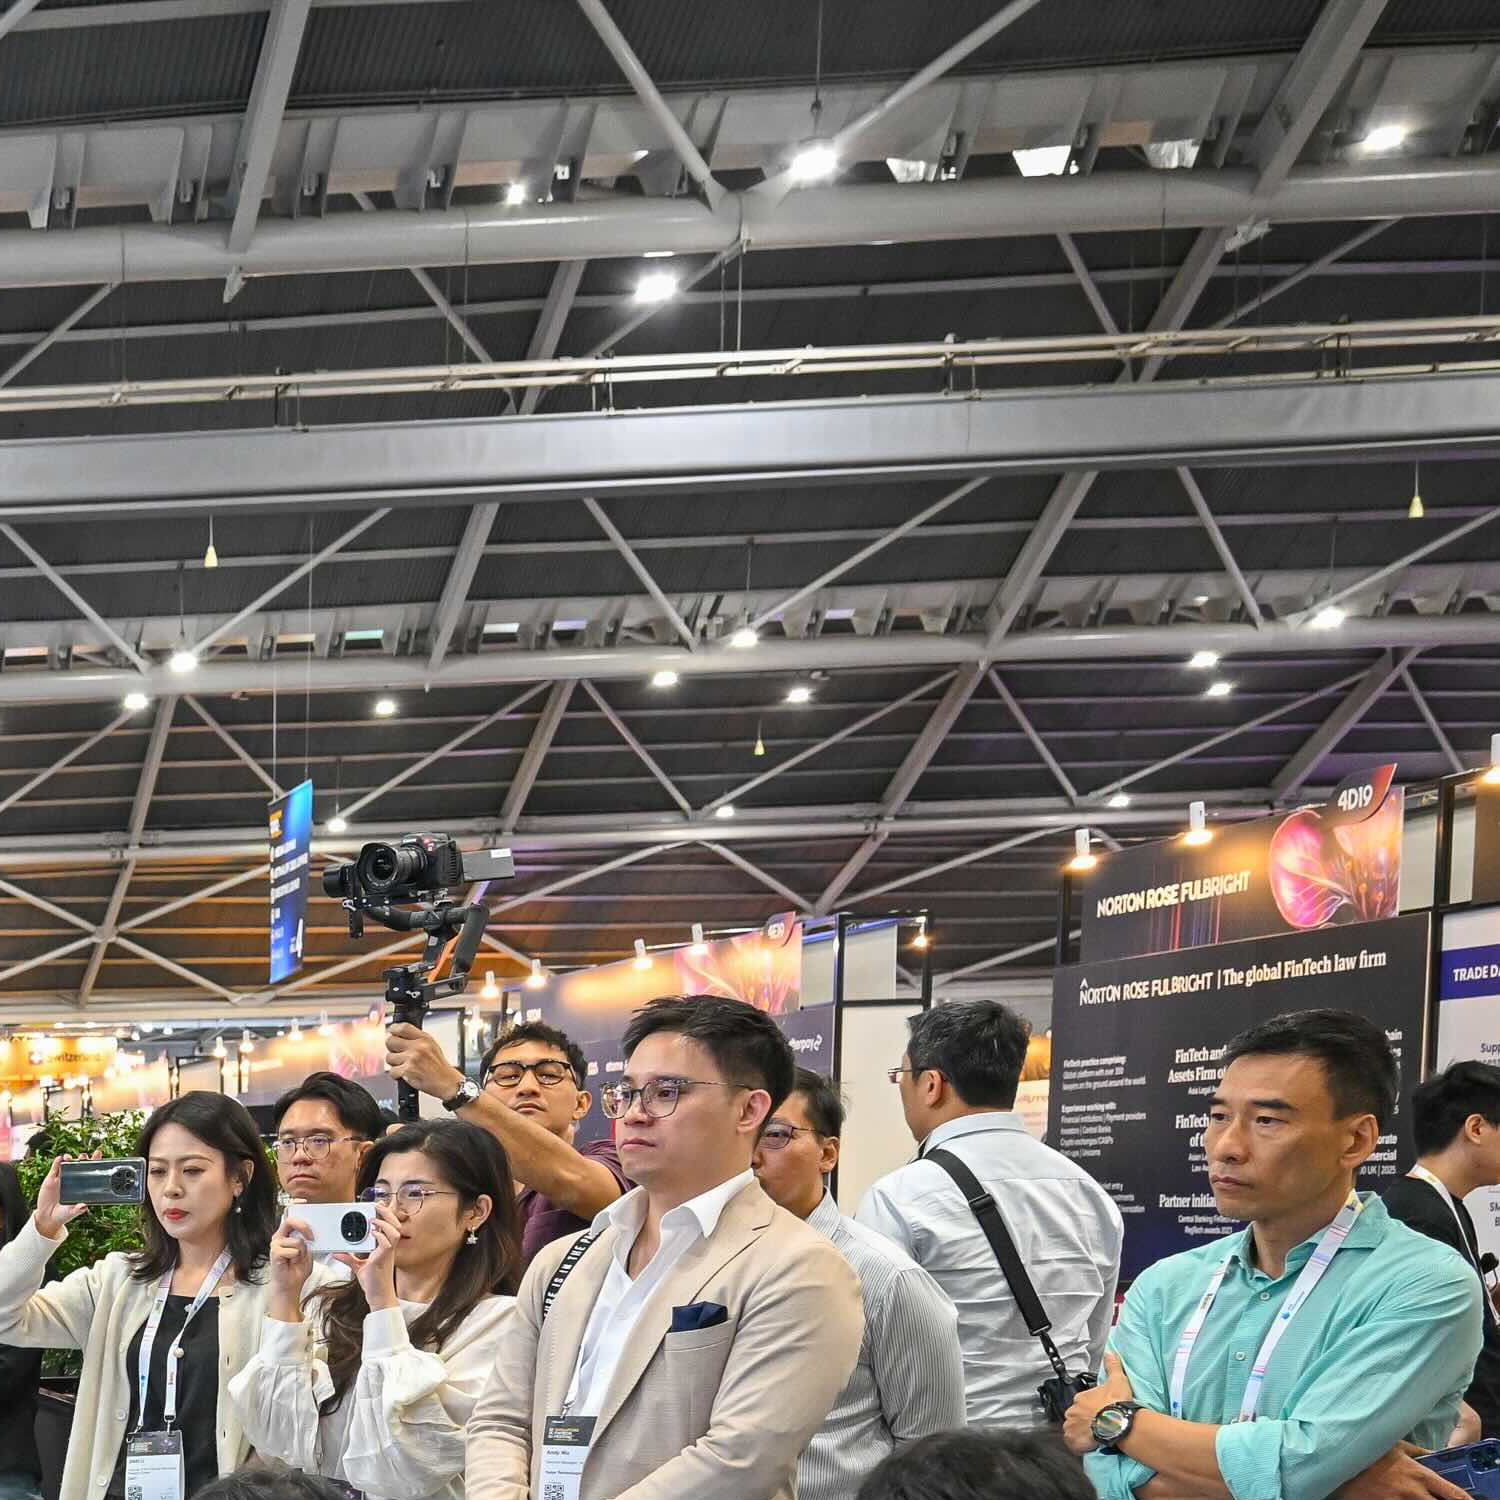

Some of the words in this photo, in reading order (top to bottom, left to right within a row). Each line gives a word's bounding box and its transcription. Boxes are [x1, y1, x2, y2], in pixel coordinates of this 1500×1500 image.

[1337, 784, 1373, 812] 4D19
[1097, 889, 1145, 918] NORTON
[1146, 884, 1179, 909] ROSE
[1180, 870, 1251, 903] FULBRIGHT
[1079, 980, 1121, 1005] NORTON
[1122, 981, 1149, 1001] ROSE
[1151, 971, 1213, 998] FULBRIGHT
[1223, 969, 1244, 987] The
[1245, 962, 1282, 987] global
[1283, 956, 1332, 981] FinTech
[1333, 954, 1357, 971] law
[1358, 950, 1387, 968] firm
[1453, 965, 1489, 982] TRADE
[1490, 964, 1500, 978] D
[1175, 1047, 1209, 1063] FinTech
[1168, 1069, 1195, 1084] Assets
[1195, 1066, 1216, 1081] Firm
[1175, 1113, 1209, 1129] FinTech
[1159, 1193, 1191, 1208] Partner
[1192, 1193, 1217, 1208] initia
[551, 1278, 564, 1288] IS
[559, 1264, 573, 1274] IN
[567, 1246, 587, 1261] THE
